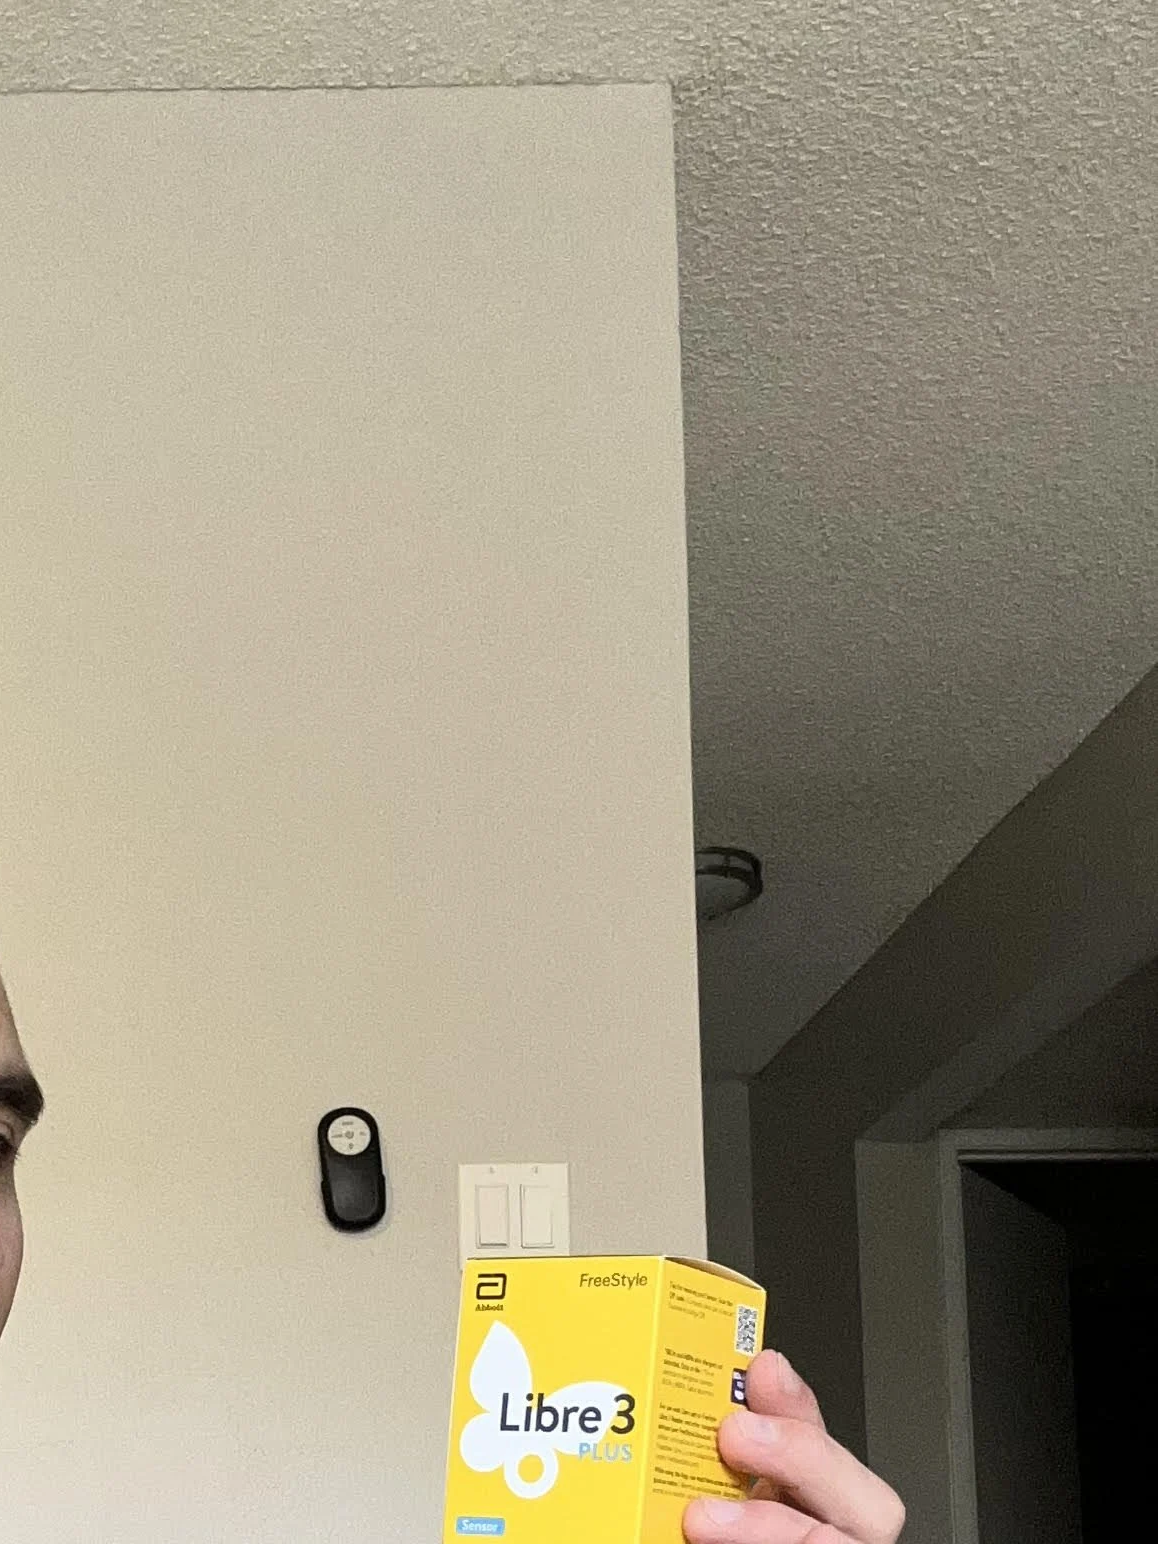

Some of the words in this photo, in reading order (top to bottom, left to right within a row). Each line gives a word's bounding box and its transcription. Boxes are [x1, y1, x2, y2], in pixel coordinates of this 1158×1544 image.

[579, 1272, 648, 1290] FreeStyle
[499, 1392, 602, 1434] Libre
[610, 1393, 637, 1435] 3
[578, 1442, 633, 1462] PLUS
